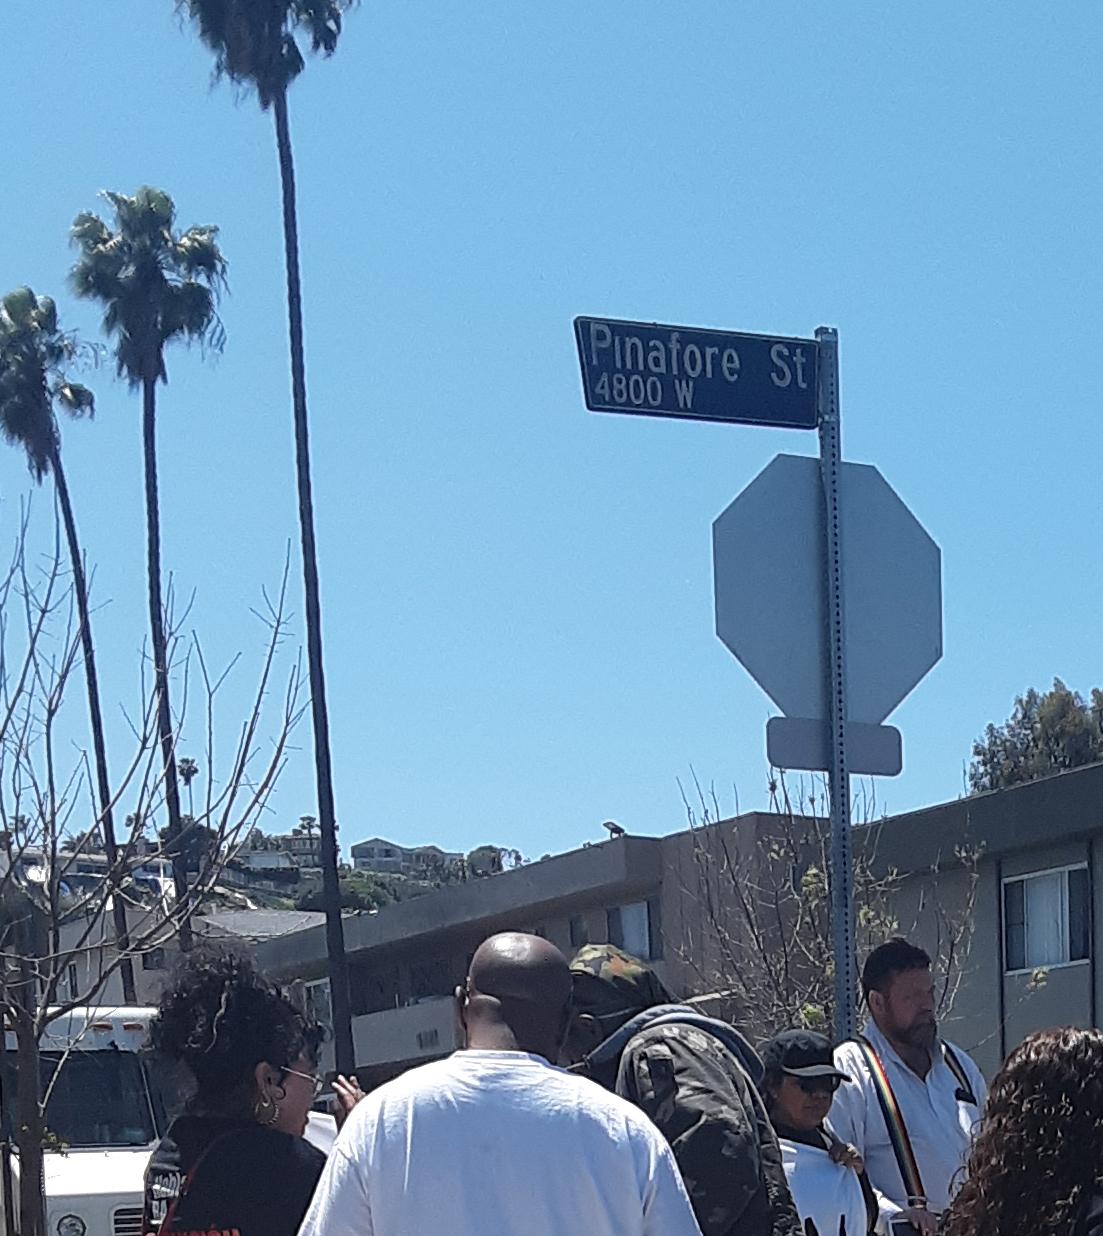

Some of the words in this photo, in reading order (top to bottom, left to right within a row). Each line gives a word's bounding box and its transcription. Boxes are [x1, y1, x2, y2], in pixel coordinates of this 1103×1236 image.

[589, 322, 740, 382] Pinafore
[770, 343, 807, 389] St
[594, 372, 662, 406] 4800
[674, 378, 694, 408] W
